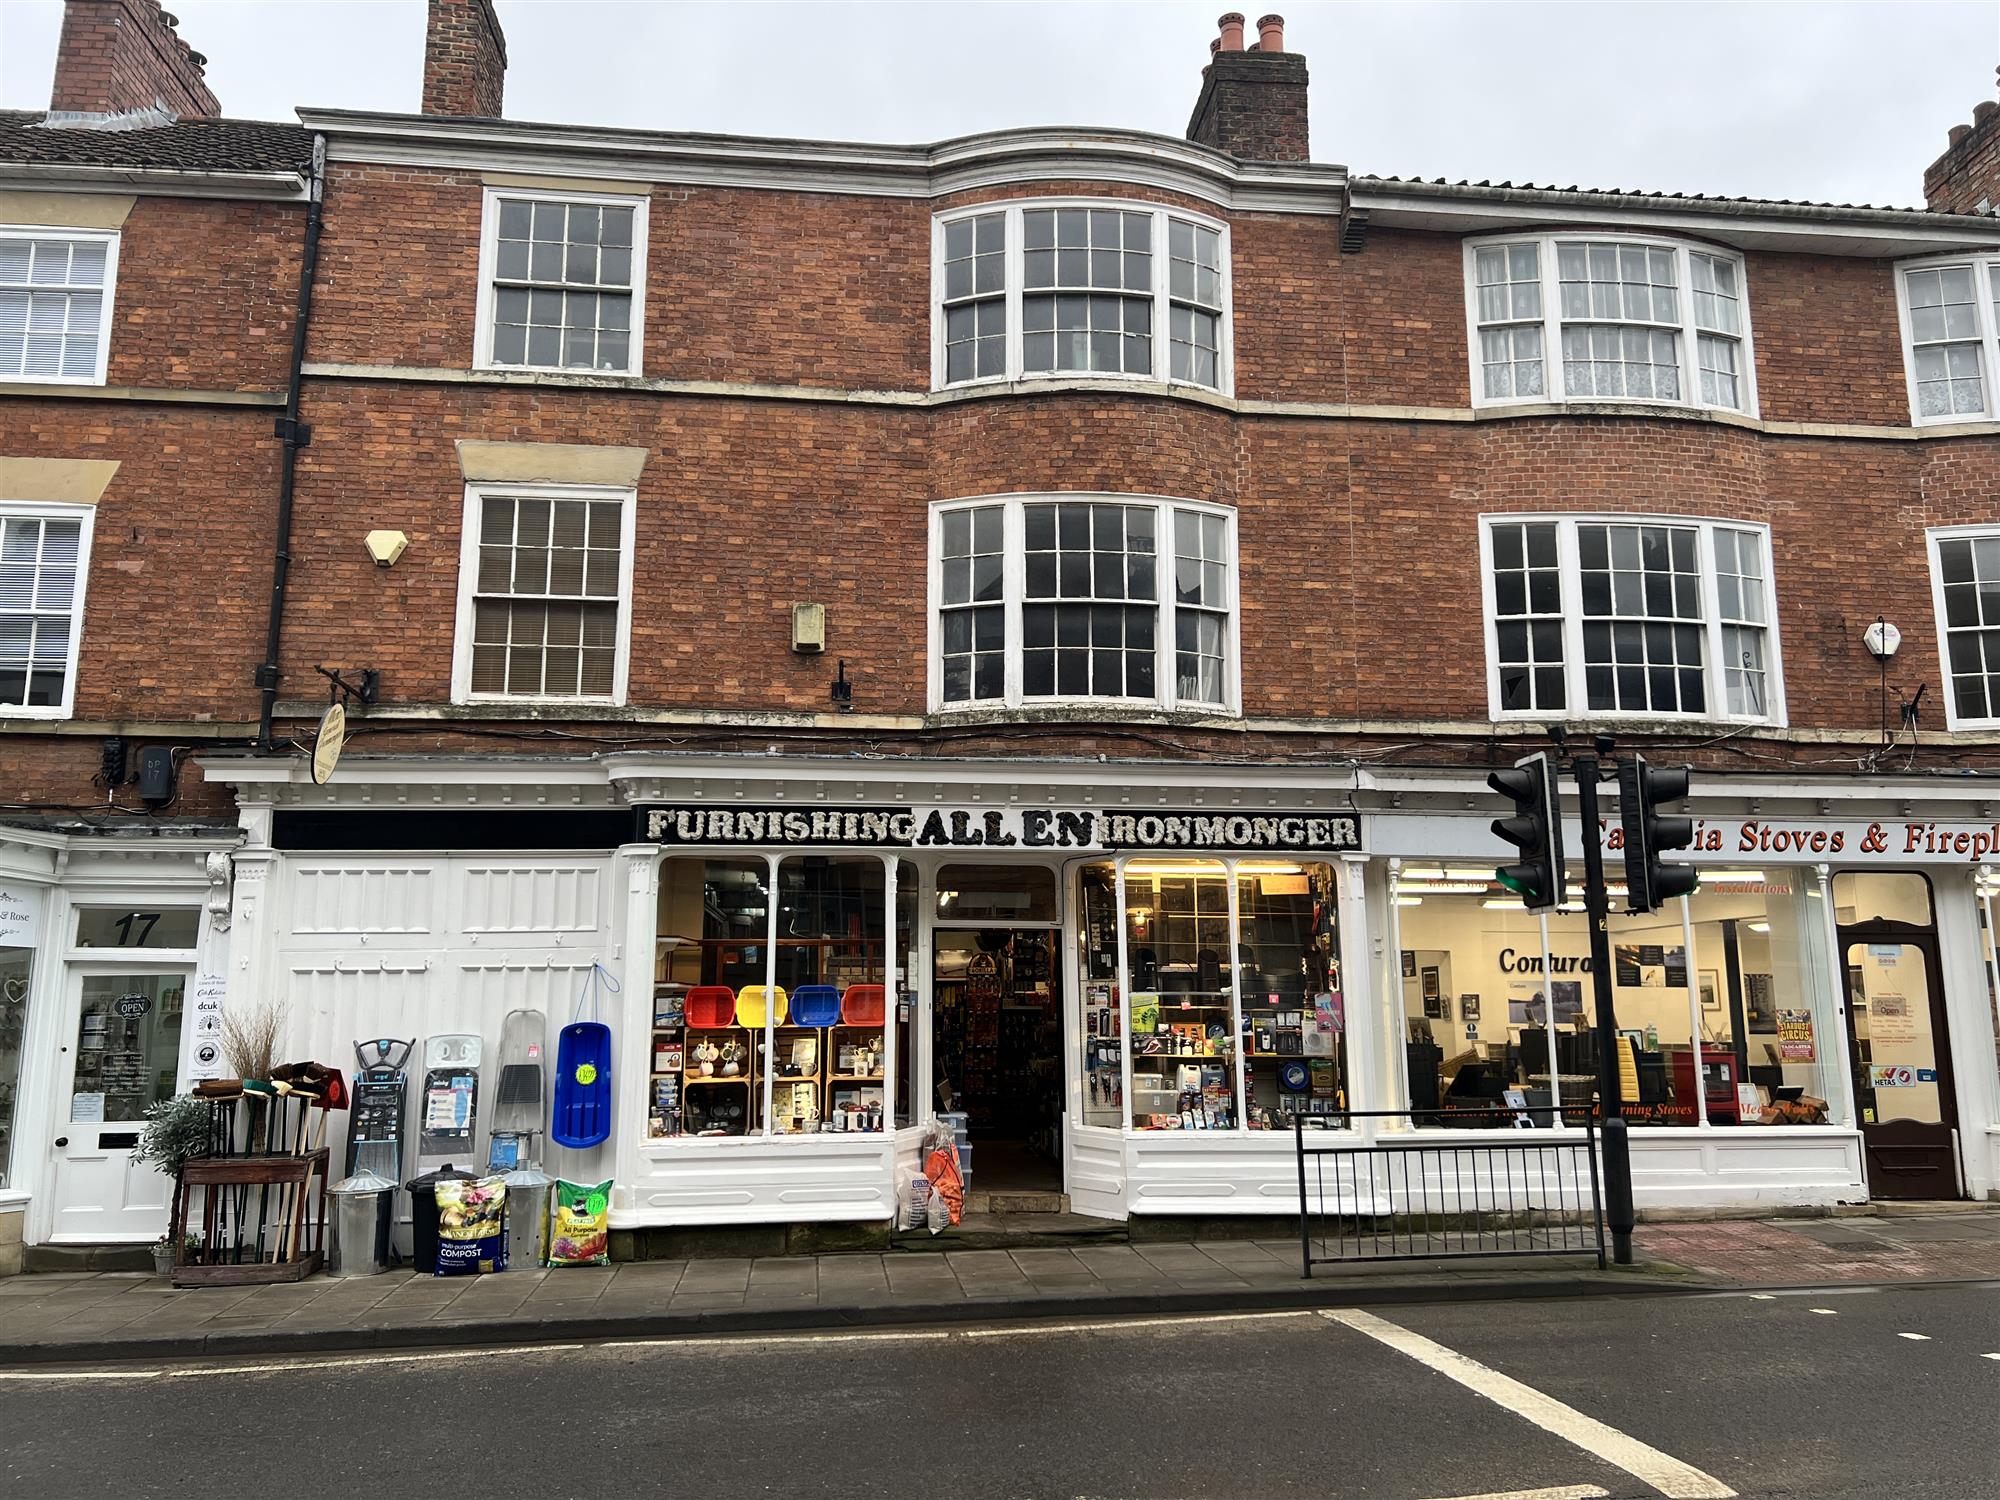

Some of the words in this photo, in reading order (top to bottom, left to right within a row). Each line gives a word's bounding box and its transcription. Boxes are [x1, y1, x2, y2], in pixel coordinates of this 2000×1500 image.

[647, 808, 917, 843] FURNISHING
[915, 809, 1096, 847] ALLEN
[1095, 814, 1359, 846] IRONMONGER
[1738, 820, 1845, 853] Stoves
[1861, 821, 1888, 853] &
[10, 911, 30, 922] Rose
[115, 912, 161, 946] 17
[121, 1002, 145, 1013] OPEN
[197, 1001, 218, 1010] dcuk
[1880, 1006, 1900, 1016] Open
[1779, 1022, 1809, 1031] STARDUST
[1780, 1030, 1810, 1041] CIRCUS
[1619, 1103, 1652, 1118] rning
[1656, 1102, 1693, 1116] Stoves
[573, 1226, 598, 1234] Purpose
[440, 1248, 482, 1258] COMPOST
